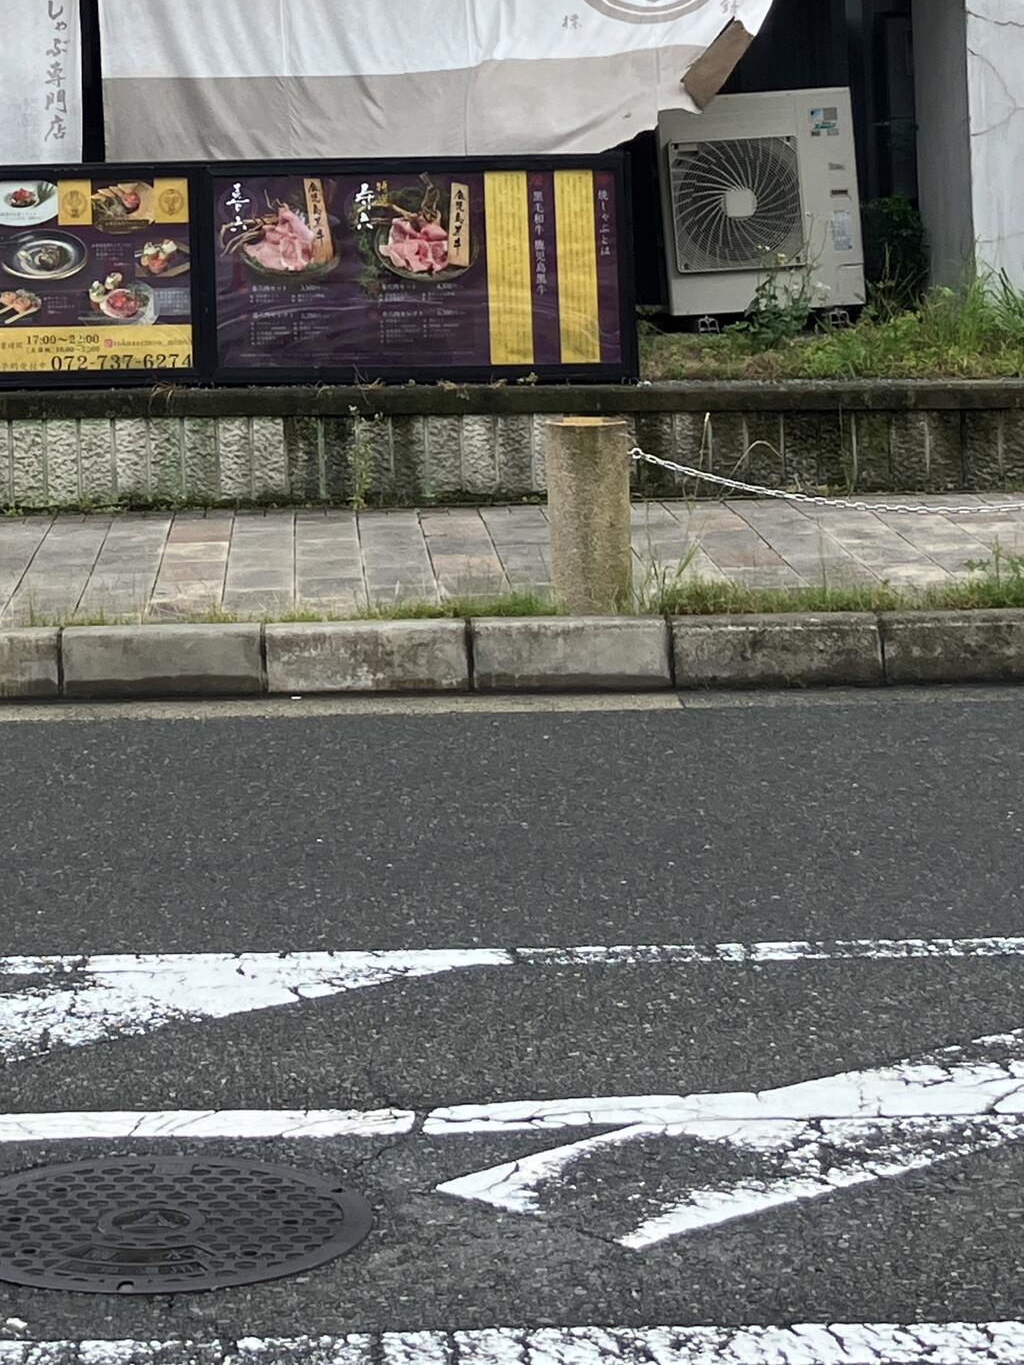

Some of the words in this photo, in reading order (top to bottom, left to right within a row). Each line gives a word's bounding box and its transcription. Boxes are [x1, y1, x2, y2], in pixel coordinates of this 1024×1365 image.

[533, 191, 545, 235] 黒毛和牛
[51, 354, 191, 371] 072-737-6274
